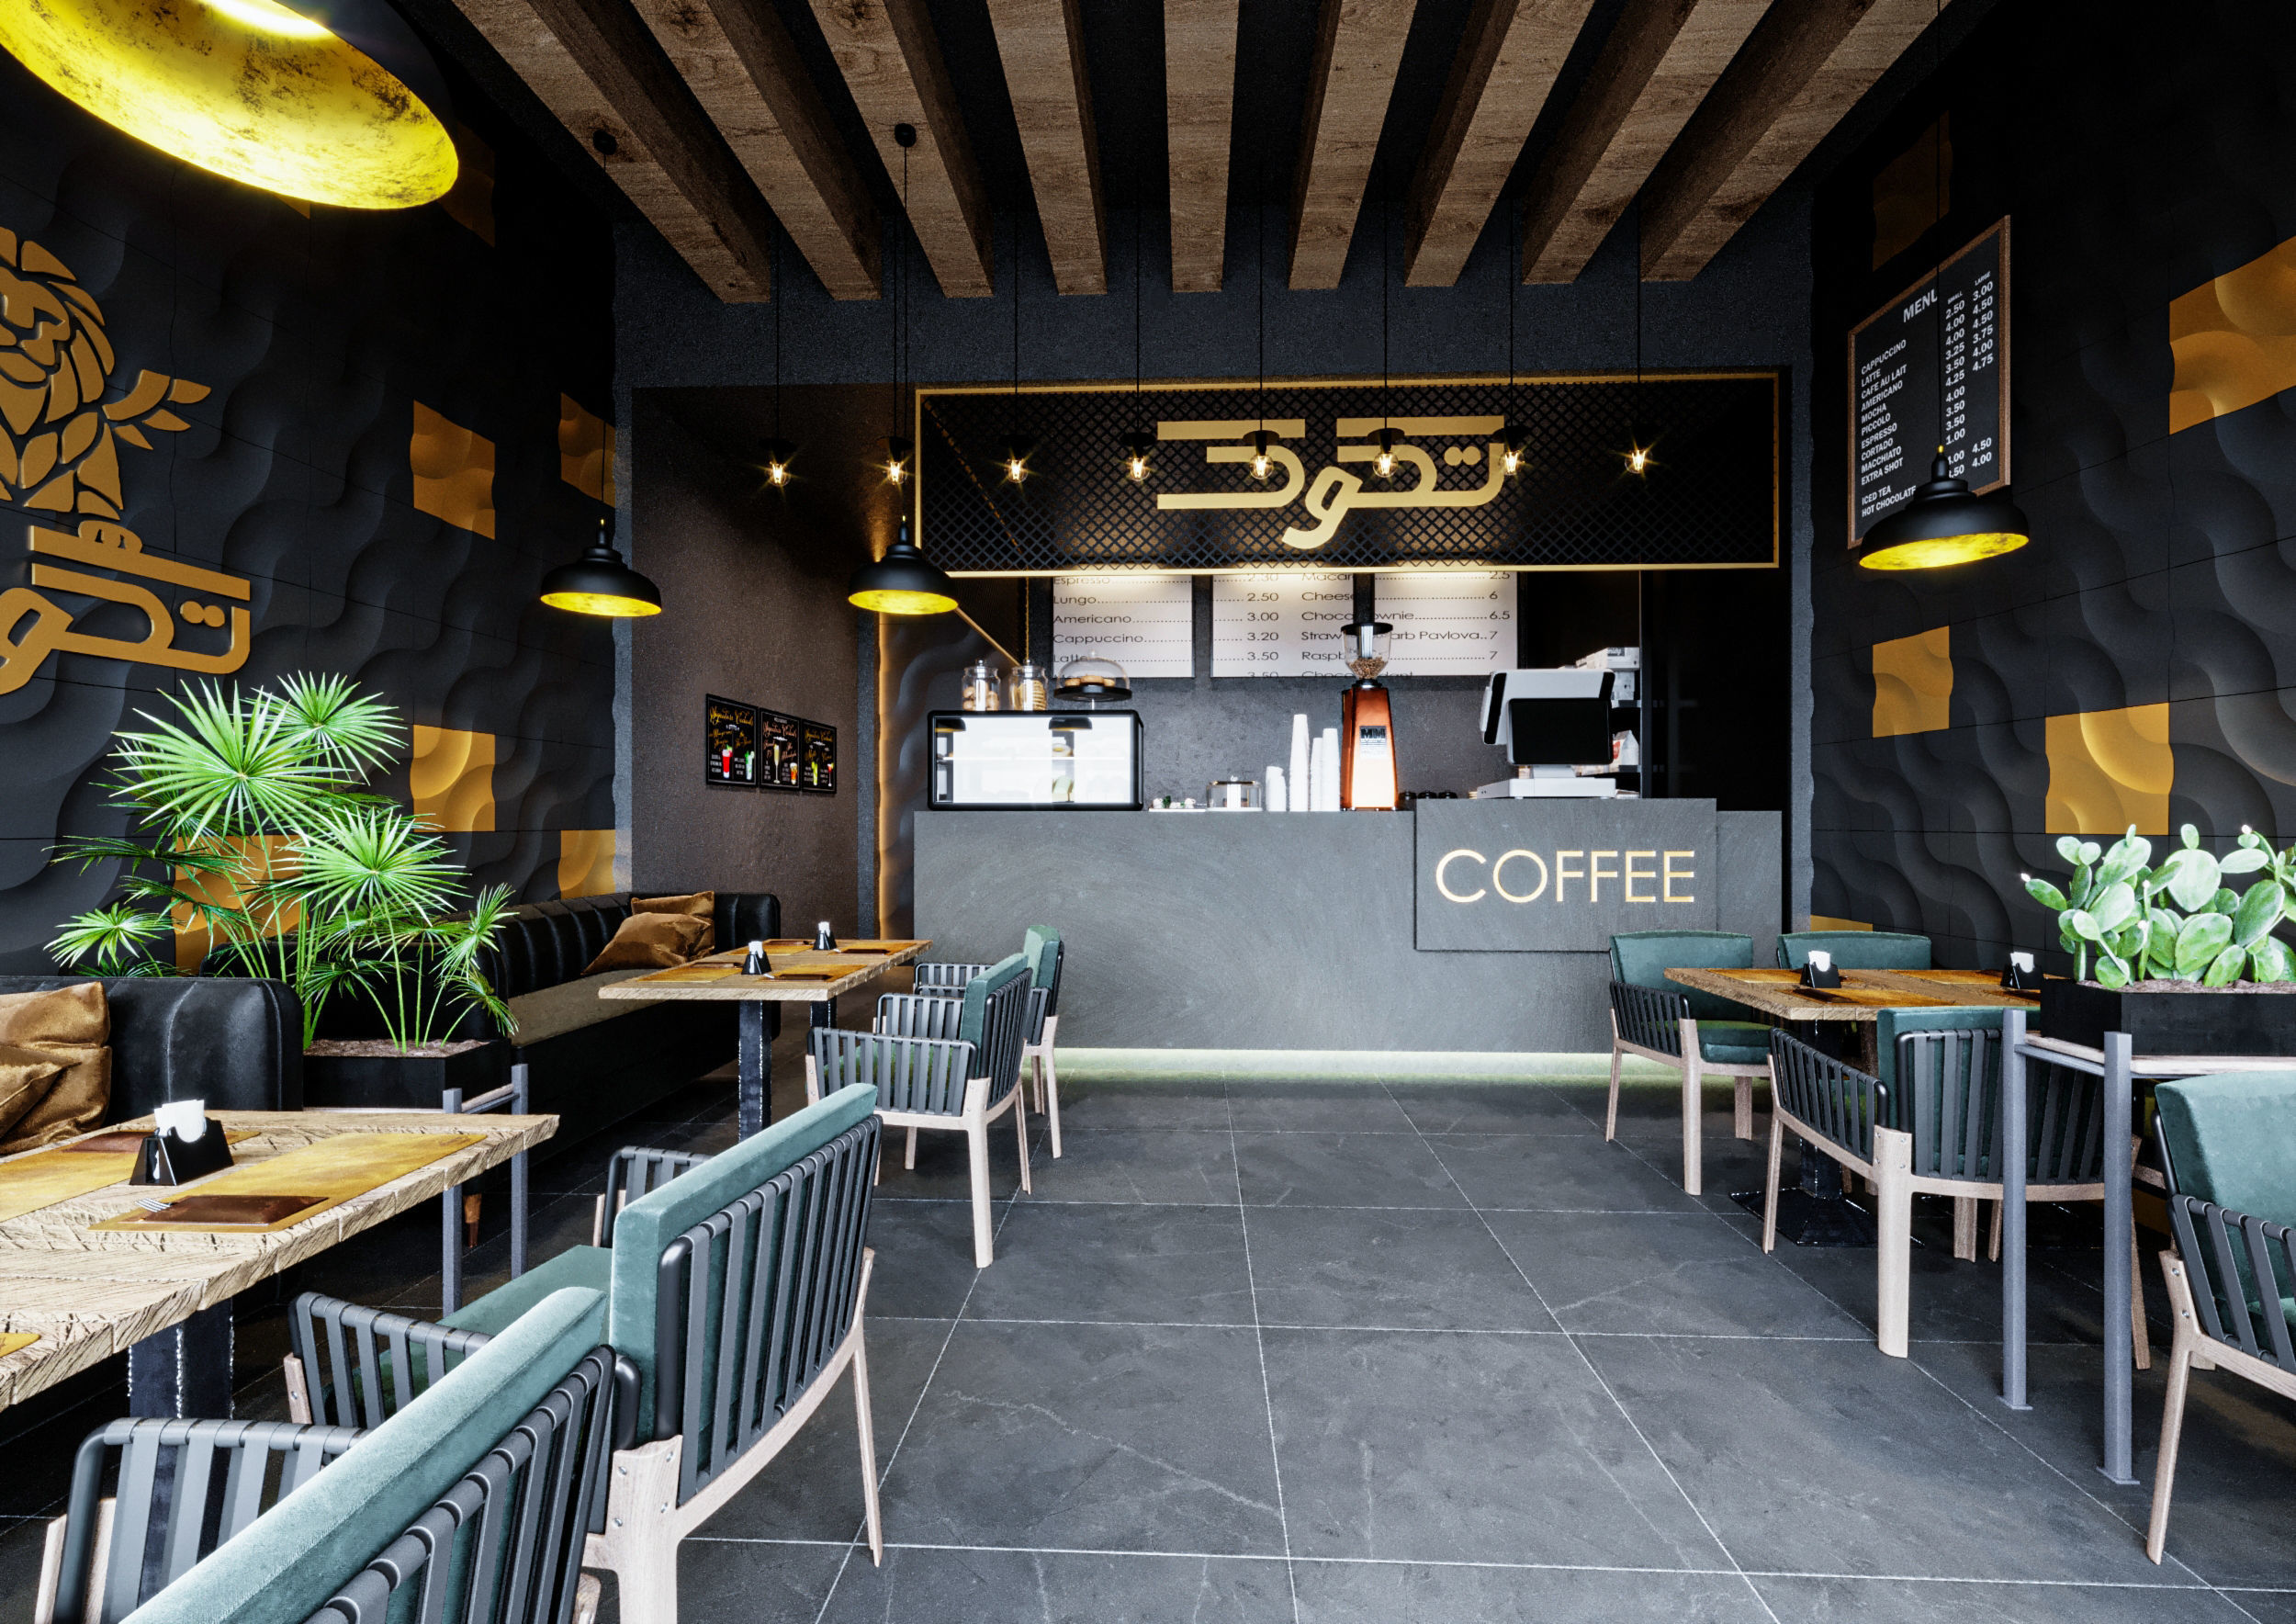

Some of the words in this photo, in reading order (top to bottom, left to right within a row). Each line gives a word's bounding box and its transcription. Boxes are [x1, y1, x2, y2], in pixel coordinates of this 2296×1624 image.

[1861, 339, 1907, 375] CAPPUCCINO
[1945, 300, 1965, 320] 2.50
[1973, 281, 1994, 301] 3.00
[1861, 368, 1881, 387] LATTE
[1945, 314, 1965, 332] 4.00
[1973, 296, 1994, 314] 4.50
[1861, 382, 1879, 399] CAFE
[1880, 375, 1890, 389] AU
[1891, 364, 1908, 381] LAIT
[1945, 328, 1965, 346] 4.00
[1973, 310, 1994, 329] 4.50
[1861, 379, 1903, 412] AMERICANO
[1945, 342, 1965, 360] 3.25
[1973, 324, 1994, 344] 3.75
[1861, 402, 1886, 423] MOCHA
[1945, 355, 1965, 374] 3.50
[1973, 339, 1994, 357] 4.00
[1861, 412, 1891, 436] PICCOLO
[1945, 369, 1965, 387] 4.25
[1973, 353, 1994, 371] 4.75
[1861, 423, 1897, 449] ESPRESSO
[1945, 386, 1965, 402] 4.00
[1861, 437, 1894, 461] CORTADO
[1945, 400, 1965, 417] 3.50
[1861, 445, 1902, 473] MACCHIATO
[1945, 414, 1965, 431] 3.50
[1861, 468, 1883, 485] EXTRA
[1884, 457, 1903, 474] SHOT
[1945, 428, 1965, 445] 1.00
[1862, 491, 1877, 505] ICED
[1878, 485, 1892, 497] TEA
[1972, 437, 1992, 454] 4.50
[1862, 504, 1874, 517] HOT
[1972, 451, 1992, 468] 4.00
[1053, 595, 1097, 605] Lungo
[1246, 592, 1279, 602] 2.50
[1301, 572, 1354, 581] Macar
[1489, 591, 1498, 600] 6
[1053, 614, 1131, 624] Americano
[1246, 612, 1279, 621] 3.00
[1053, 633, 1144, 645] Cappuccino
[1246, 631, 1279, 641] 3.20
[1419, 630, 1480, 640] Pavlova
[1489, 611, 1511, 620] 6.5
[1246, 651, 1279, 660] 3.50
[1435, 849, 1695, 903] COFFEE
